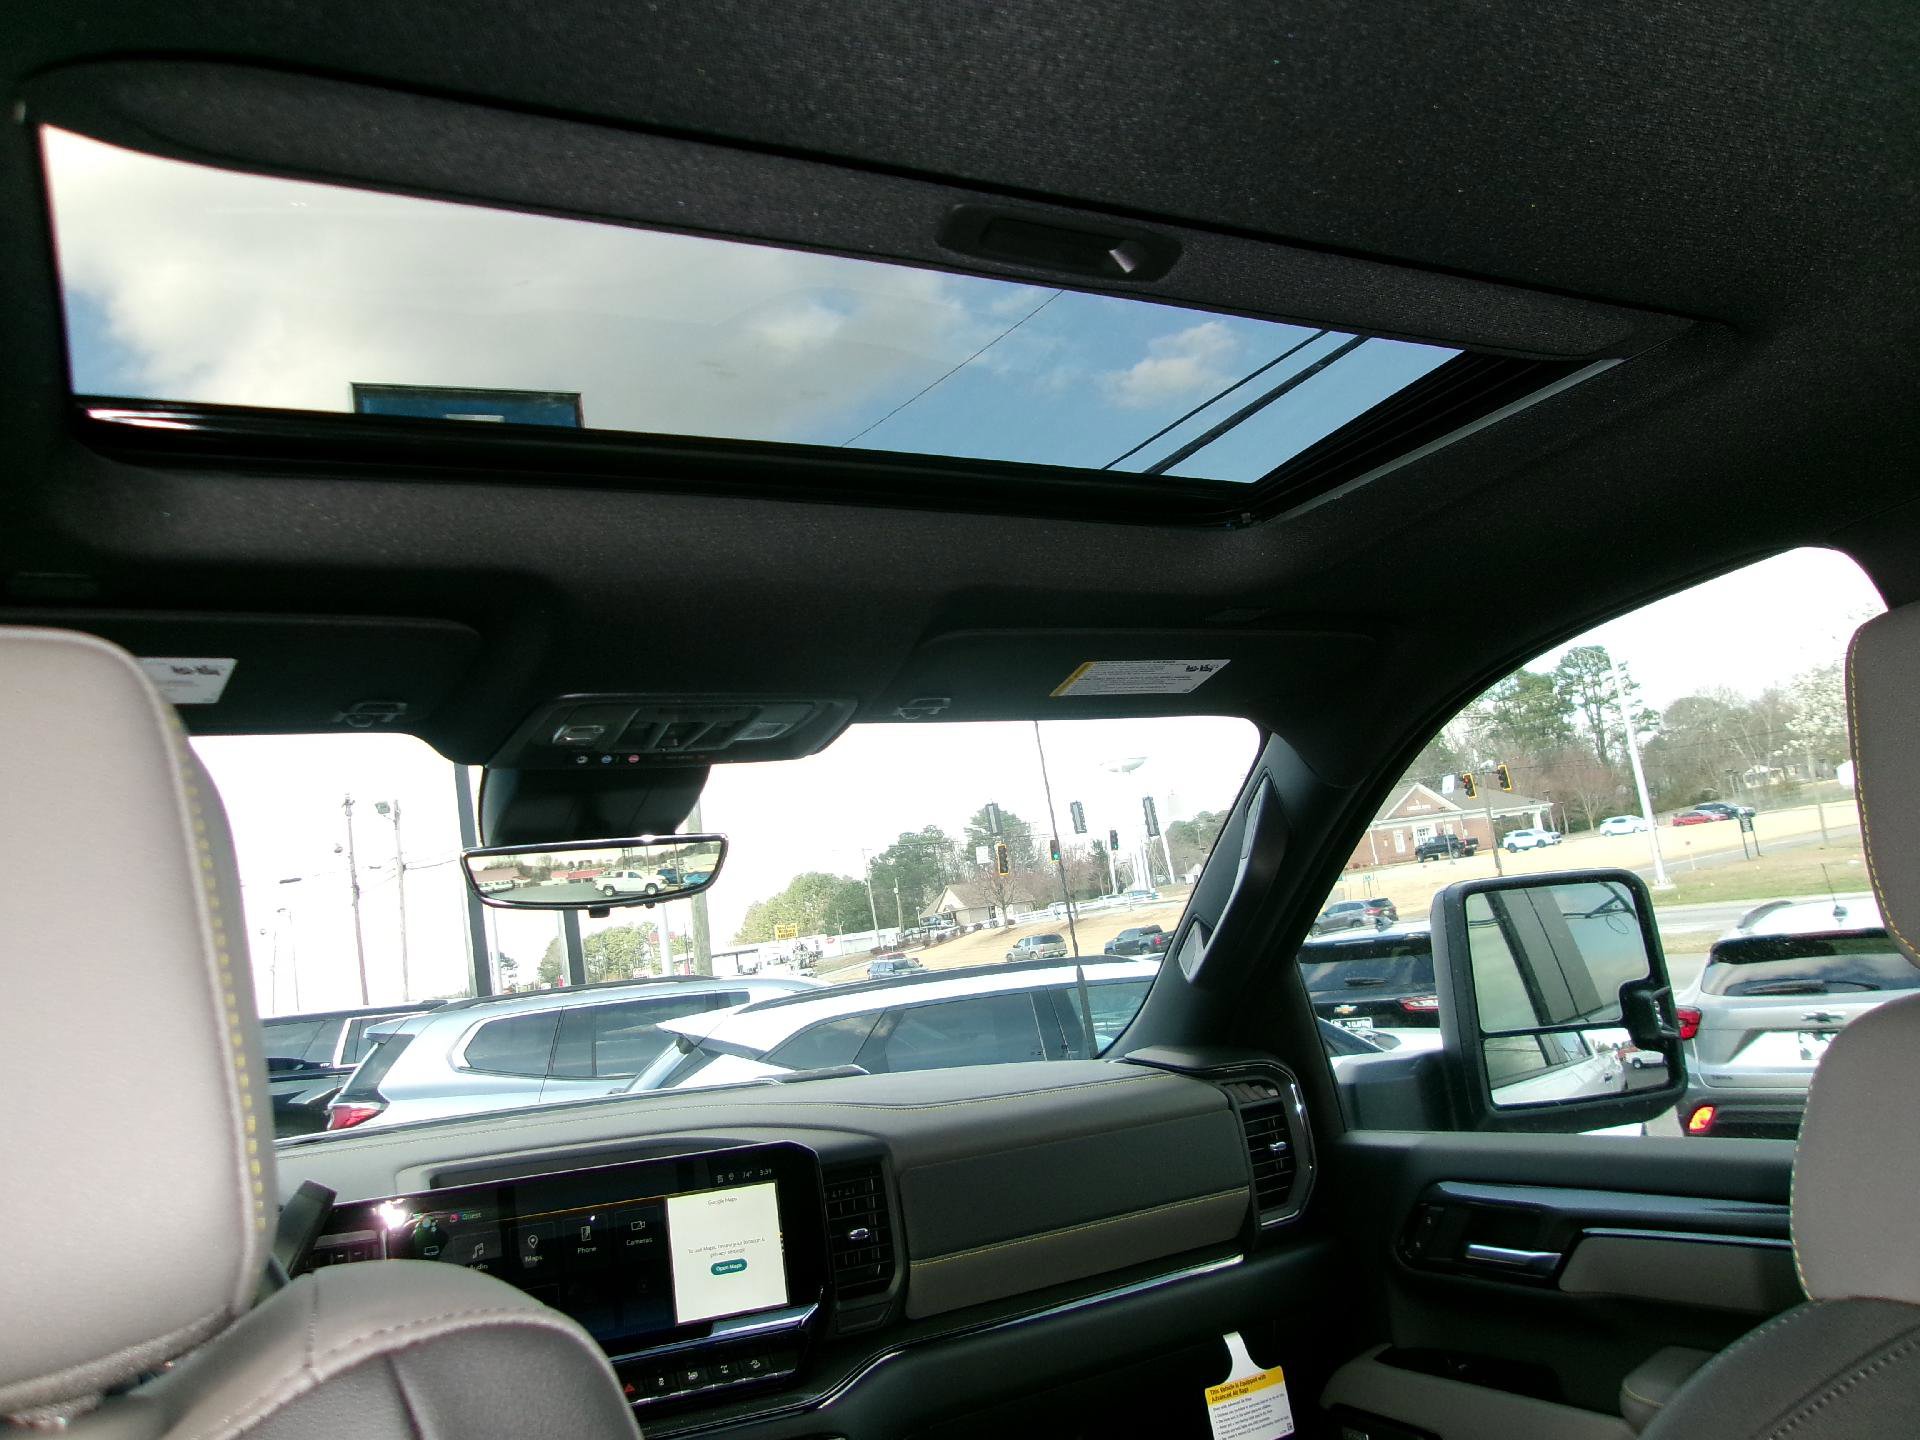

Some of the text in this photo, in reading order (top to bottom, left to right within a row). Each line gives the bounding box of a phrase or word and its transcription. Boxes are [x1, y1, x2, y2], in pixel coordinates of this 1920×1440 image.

[462, 1212, 482, 1221] Guest
[626, 1236, 653, 1246] Cameras
[577, 1245, 597, 1254] Phone
[524, 1254, 543, 1263] Maps
[1210, 1387, 1220, 1395] This
[1211, 1391, 1232, 1401] Advanced
